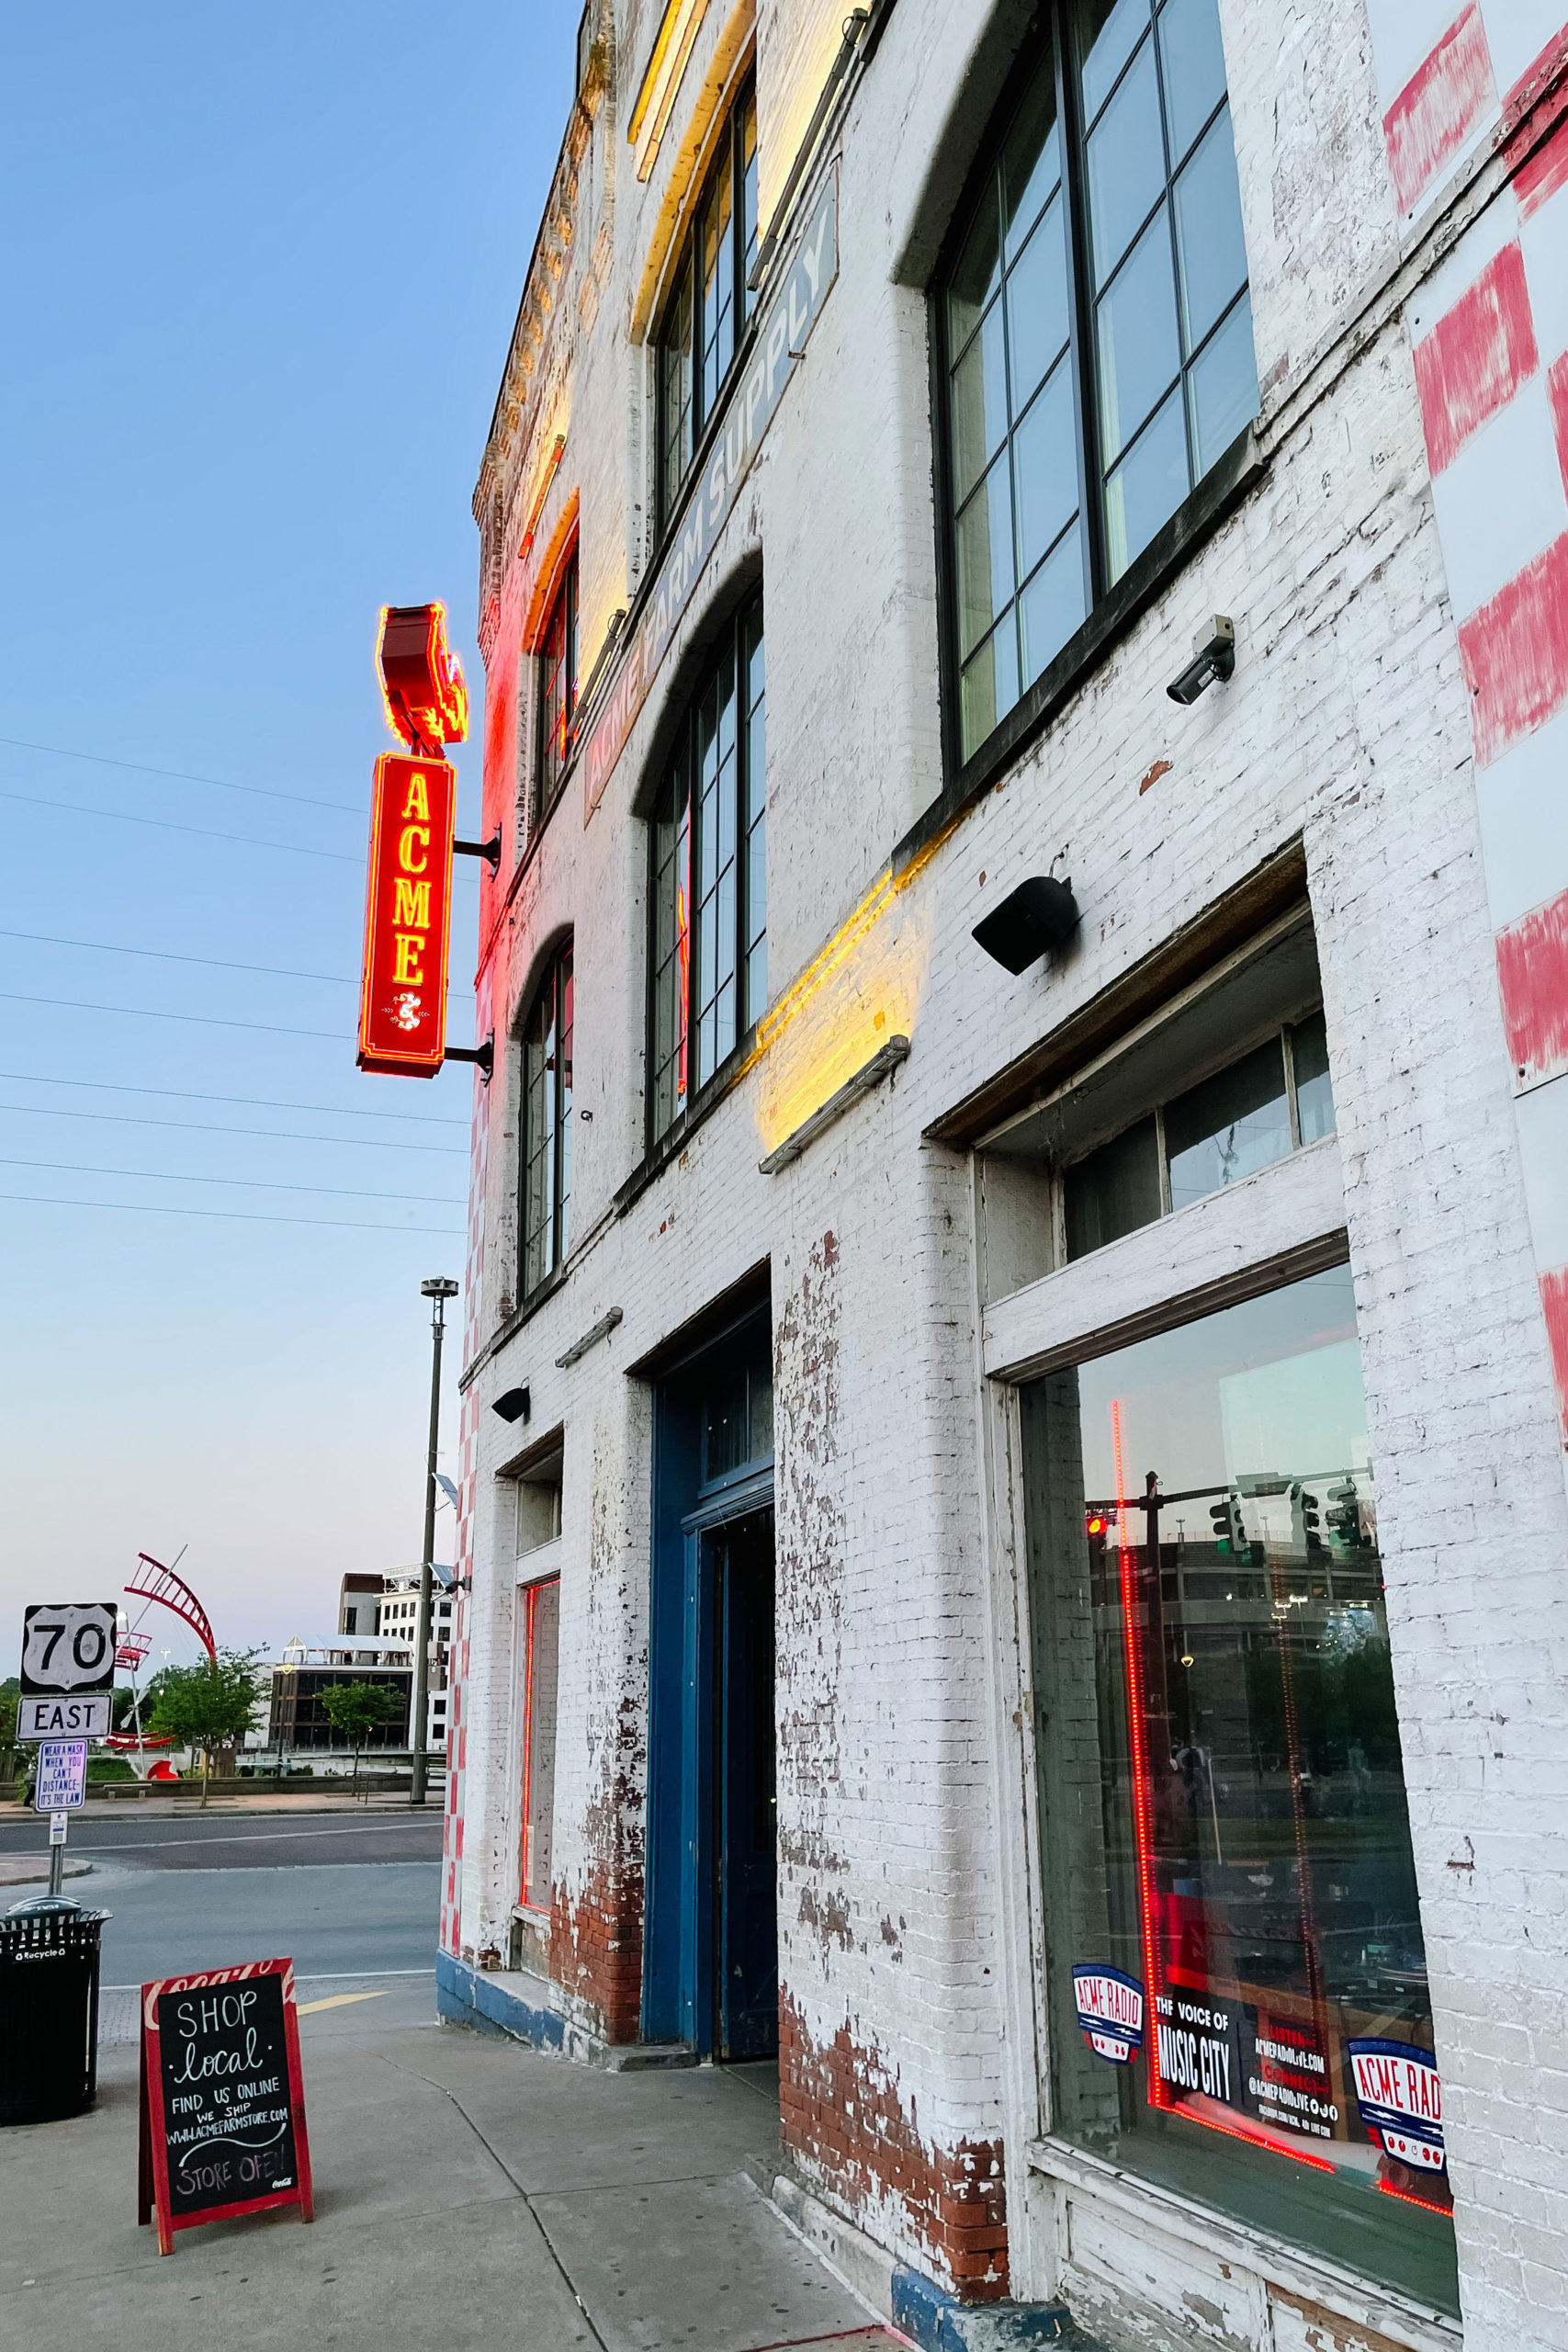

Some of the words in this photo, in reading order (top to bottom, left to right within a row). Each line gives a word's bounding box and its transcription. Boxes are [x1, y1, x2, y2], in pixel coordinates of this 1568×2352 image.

[589, 646, 641, 802] ACME
[709, 204, 829, 526] SUPPLY
[392, 772, 432, 987] ACME
[34, 1623, 106, 1670] 70
[34, 1704, 96, 1730] EAST
[45, 1746, 61, 1756] WEAR
[62, 1746, 66, 1756] A
[67, 1745, 83, 1755] MASK
[46, 1758, 63, 1768] WHEN
[69, 1757, 82, 1767] YOU
[53, 1768, 72, 1779] CAN'T
[41, 1794, 51, 1805] IT'S
[54, 1793, 64, 1804] THE
[66, 1792, 80, 1804] LAW
[24, 1949, 58, 1959] Recycle
[177, 1991, 257, 2038] SHOP
[1077, 1979, 1105, 2016] ACME
[1108, 1981, 1139, 2025] RADIO
[1178, 2002, 1212, 2028] VOICE
[1213, 2012, 1229, 2031] OF
[174, 2027, 264, 2084] local
[1156, 2023, 1199, 2091] MUSIC
[1200, 2036, 1231, 2101] CITY
[172, 2095, 203, 2114] FIND
[214, 2087, 231, 2103] US
[237, 2077, 279, 2099] ONLINE
[1357, 2057, 1404, 2109] ACME
[166, 2108, 288, 2145] WWW.ACMEFARMSTORE.COM
[197, 2111, 214, 2124] WE
[224, 2102, 251, 2117] SHIP
[176, 2161, 231, 2195] STORE
